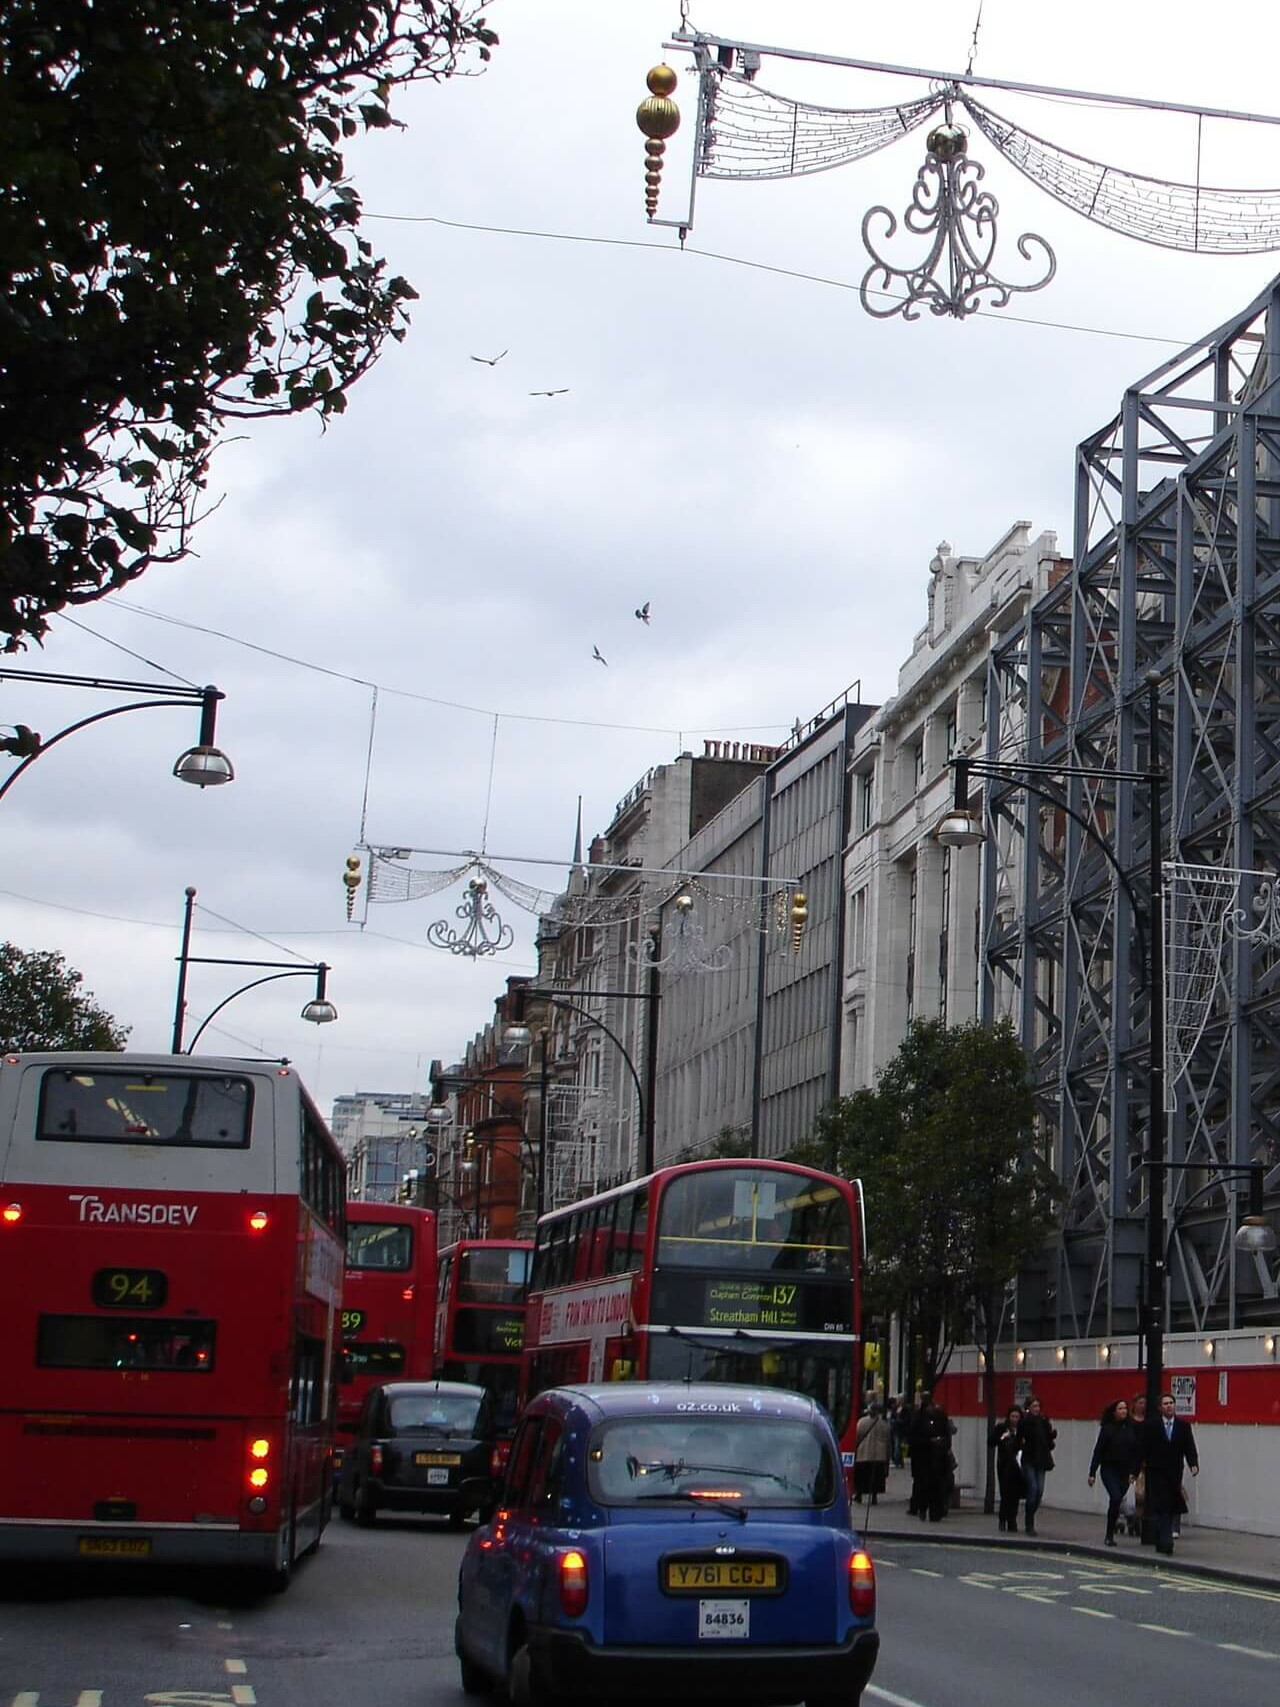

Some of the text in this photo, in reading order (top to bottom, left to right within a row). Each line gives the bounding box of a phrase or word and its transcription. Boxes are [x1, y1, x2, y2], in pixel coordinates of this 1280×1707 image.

[69, 1195, 198, 1225] TRANSDEV
[110, 1274, 152, 1302] 94
[772, 1285, 797, 1305] 137
[710, 1308, 758, 1323] Streatham
[761, 1310, 778, 1324] Hill
[676, 1402, 742, 1413] o2.co.uk
[677, 1568, 766, 1584] Y761 CGJ
[705, 1613, 744, 1625] 84836
